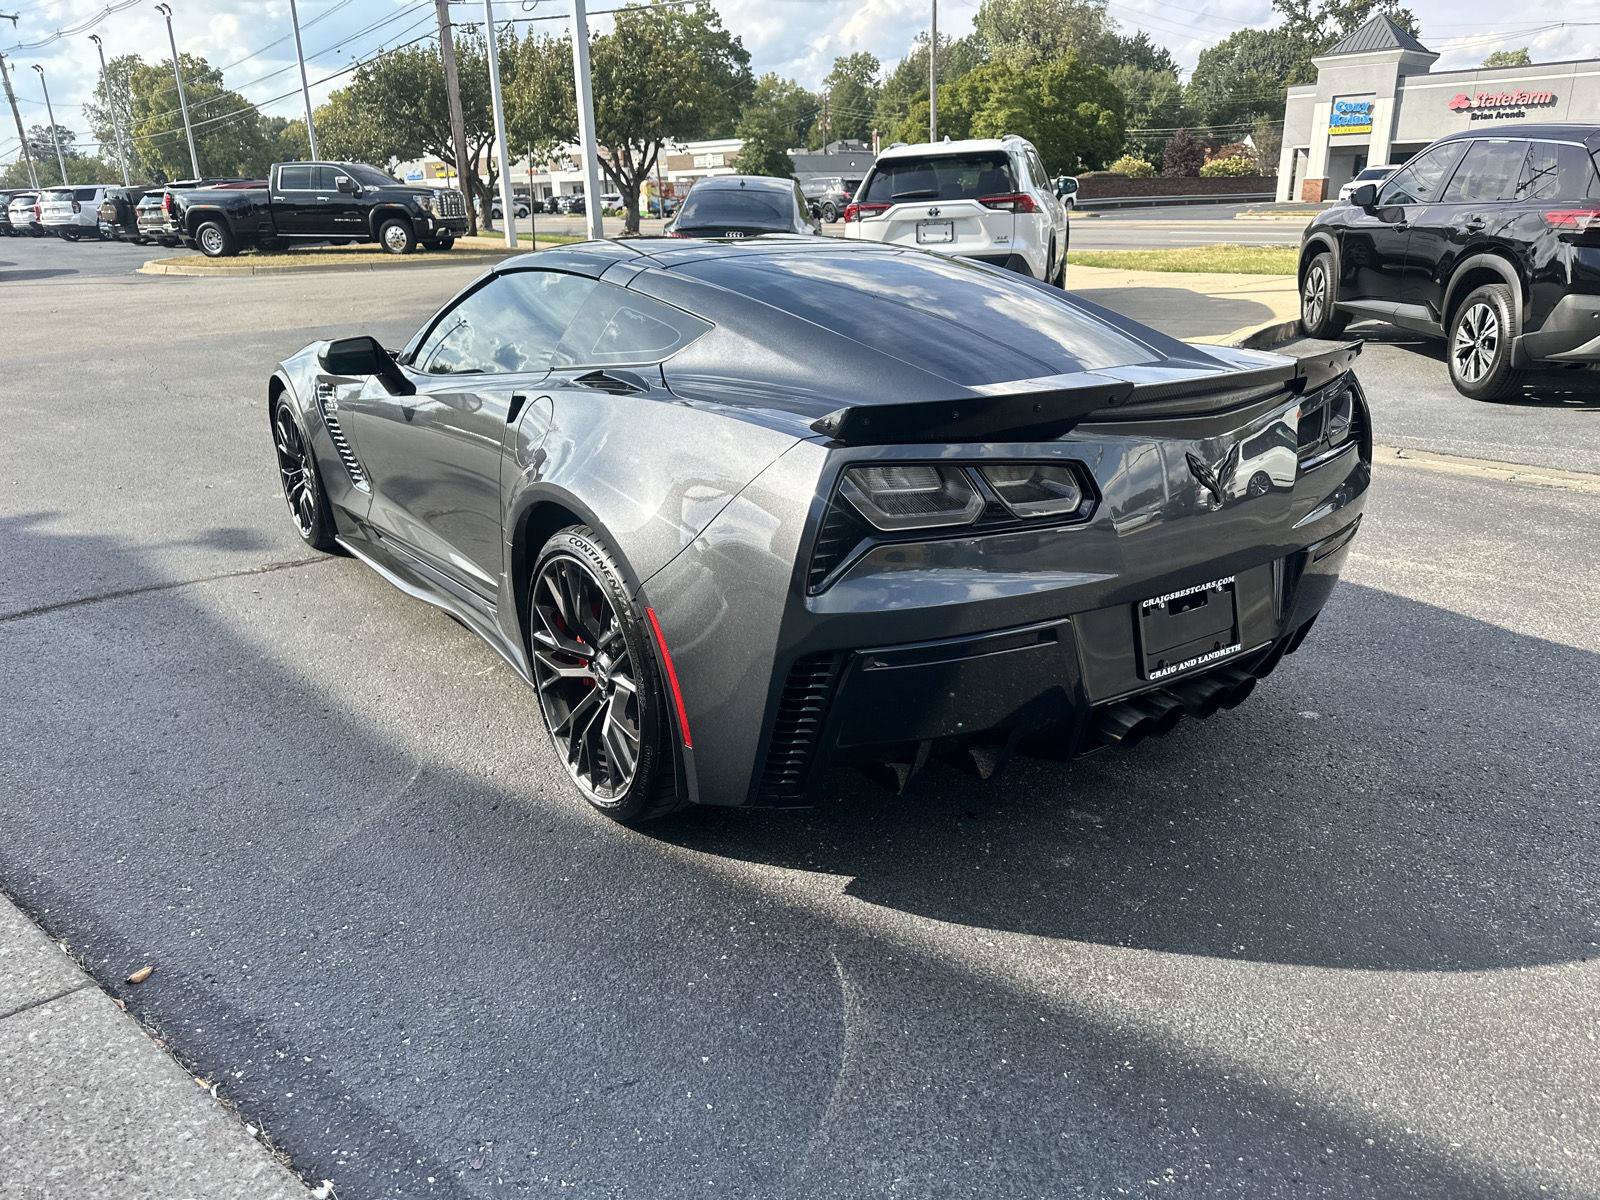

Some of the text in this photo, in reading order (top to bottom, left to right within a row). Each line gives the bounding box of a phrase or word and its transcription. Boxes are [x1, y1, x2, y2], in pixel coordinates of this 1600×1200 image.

[1471, 110, 1526, 121] Brian Arends
[1142, 575, 1235, 608] CRAIGSBESTCARS.COM
[1149, 643, 1242, 680] CRAIG AND LANDRETH
